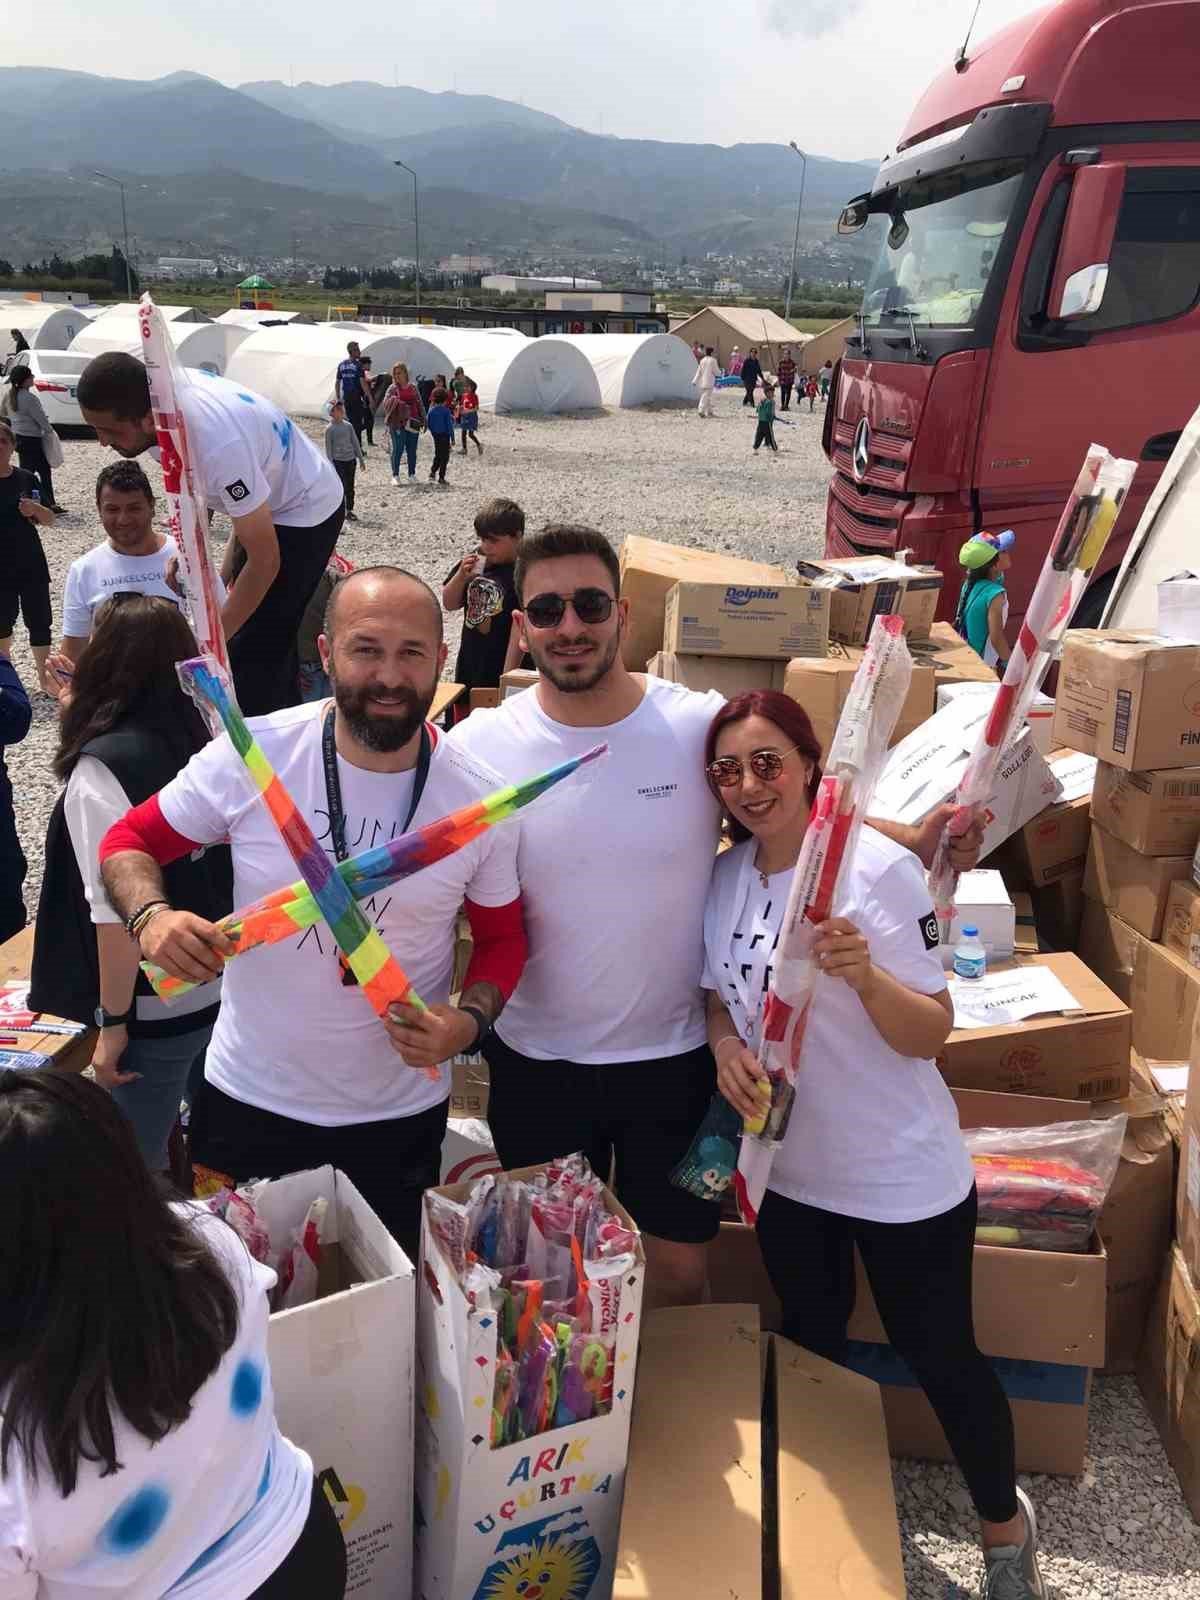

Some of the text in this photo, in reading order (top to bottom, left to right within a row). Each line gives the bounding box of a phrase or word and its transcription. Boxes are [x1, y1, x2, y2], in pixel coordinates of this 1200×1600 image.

[726, 587, 779, 600] Dolphin
[507, 1437, 590, 1486] ARIK
[473, 1473, 612, 1534] UÇURTMA
